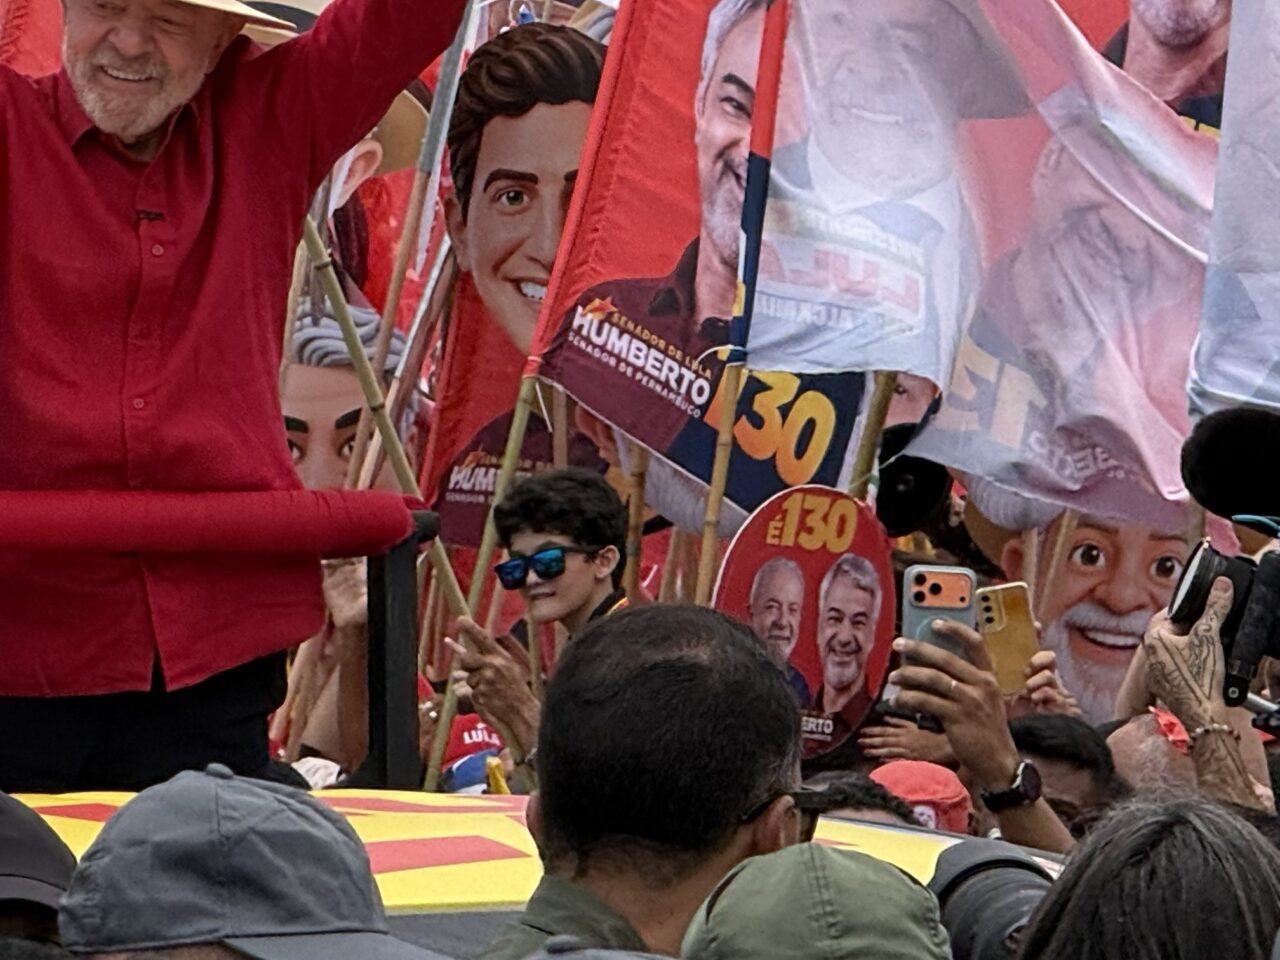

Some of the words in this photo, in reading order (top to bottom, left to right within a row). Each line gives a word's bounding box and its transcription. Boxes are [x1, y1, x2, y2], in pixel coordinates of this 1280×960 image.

[572, 305, 711, 406] HUMBERTO
[612, 312, 666, 352] SENADOR
[667, 343, 684, 362] DE
[569, 331, 617, 368] SENADOR
[618, 362, 634, 378] DE
[635, 370, 702, 418] PERNAMBUCO
[780, 492, 858, 553] 130
[800, 716, 834, 734] ERTO
